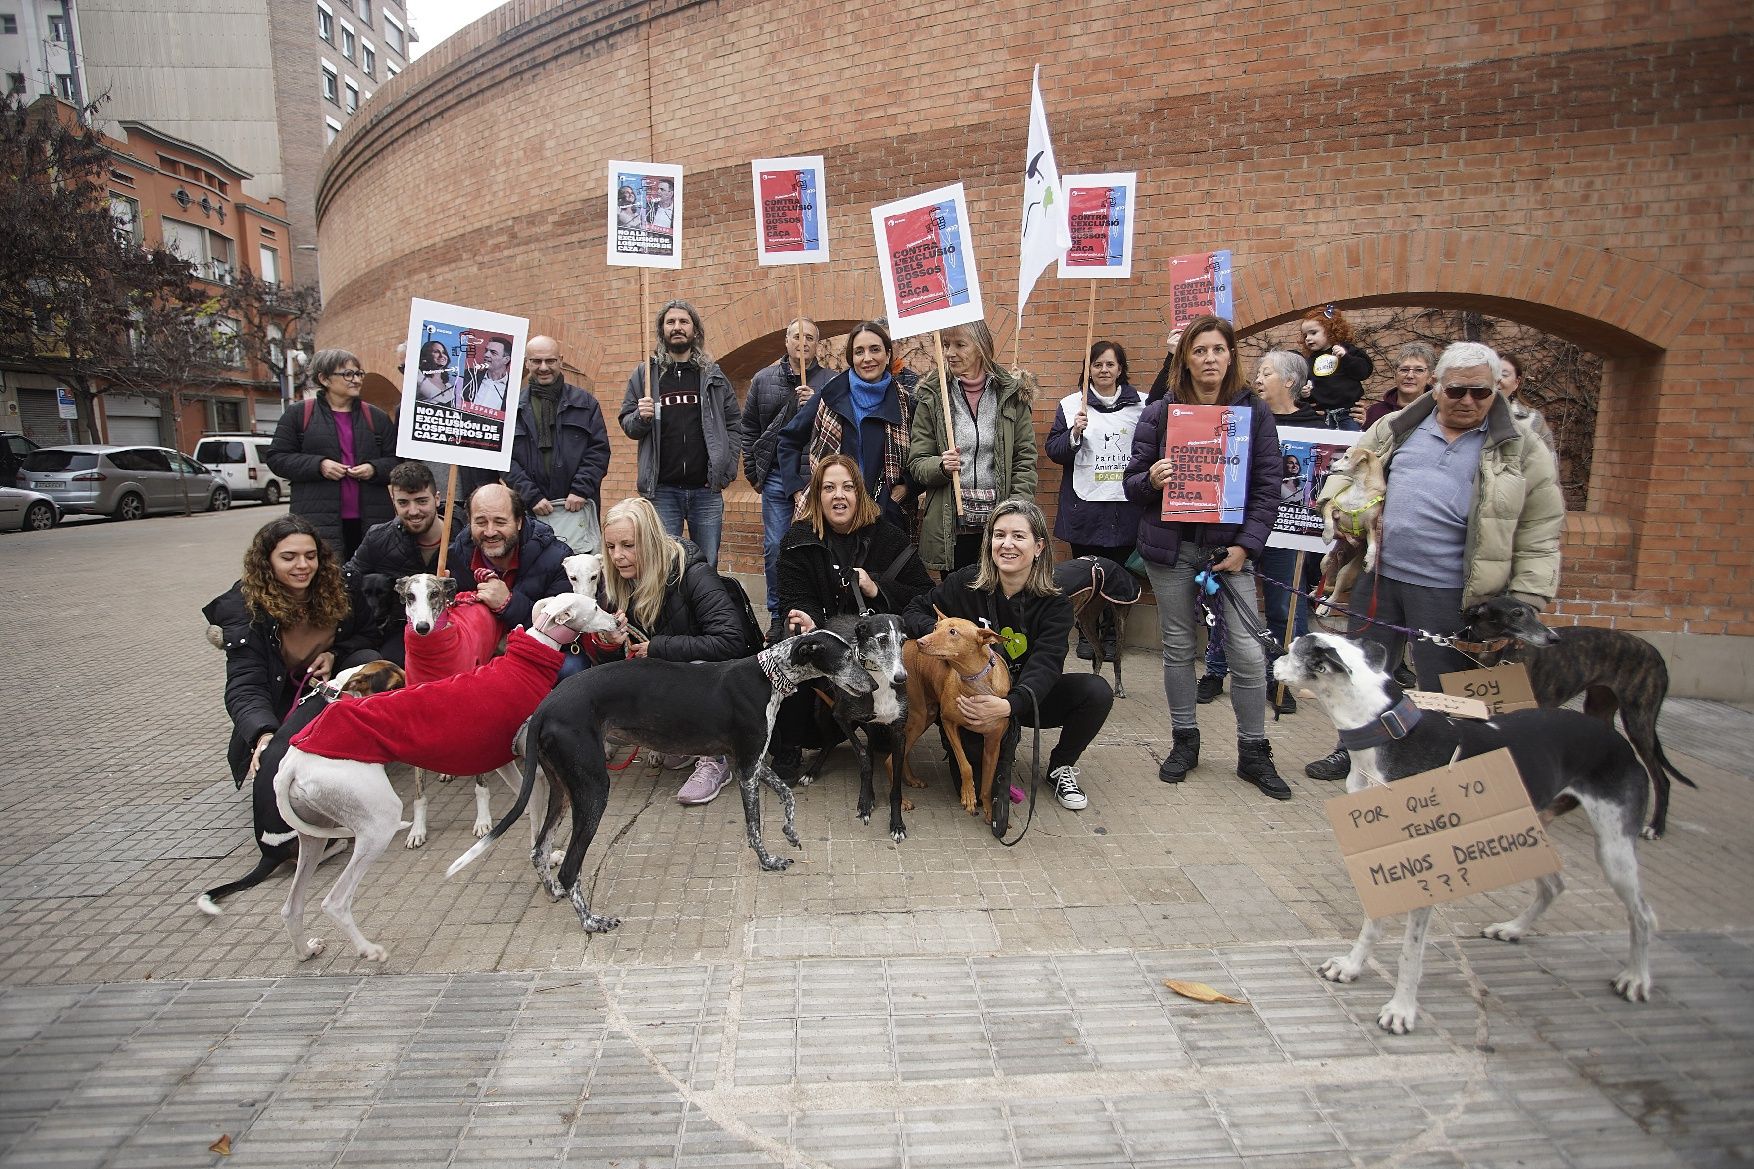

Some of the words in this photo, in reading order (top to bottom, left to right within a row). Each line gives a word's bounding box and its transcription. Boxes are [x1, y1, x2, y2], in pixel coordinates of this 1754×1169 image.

[893, 242, 939, 259] CONTRA
[894, 244, 956, 267] L'EXCLUSIÓ
[895, 262, 923, 275] DELS
[897, 266, 941, 282] GOSSOS
[898, 281, 913, 290] DE
[1174, 281, 1212, 290] CONTRA
[1174, 284, 1226, 297] L'EXCLUSIÓ
[899, 286, 930, 298] CAÇA
[1174, 295, 1198, 303] DELS
[1175, 300, 1212, 309] GOSSOS
[416, 406, 434, 416] NO
[436, 409, 444, 418] A
[446, 410, 460, 420] LA
[416, 414, 481, 431] EXCLUSIÓN
[482, 424, 498, 433] DE
[414, 430, 447, 442] CAZA
[484, 432, 500, 441] DE
[1170, 446, 1223, 455] CONTRA
[1095, 454, 1131, 462] Partido
[1171, 454, 1240, 465] L'EXCLUSIÓ
[1172, 464, 1202, 472] DELS
[1170, 473, 1220, 482] GOSSOS
[1168, 482, 1186, 490] DE
[1168, 491, 1203, 501] CAÇA
[1277, 512, 1323, 523] XCLUSIÓN
[1463, 680, 1500, 698] SOY
[1348, 805, 1389, 829] POR
[1406, 787, 1440, 813] QUÉ
[1458, 780, 1485, 798] YO
[1401, 812, 1461, 839] TENGO
[1369, 854, 1434, 886] MENOS
